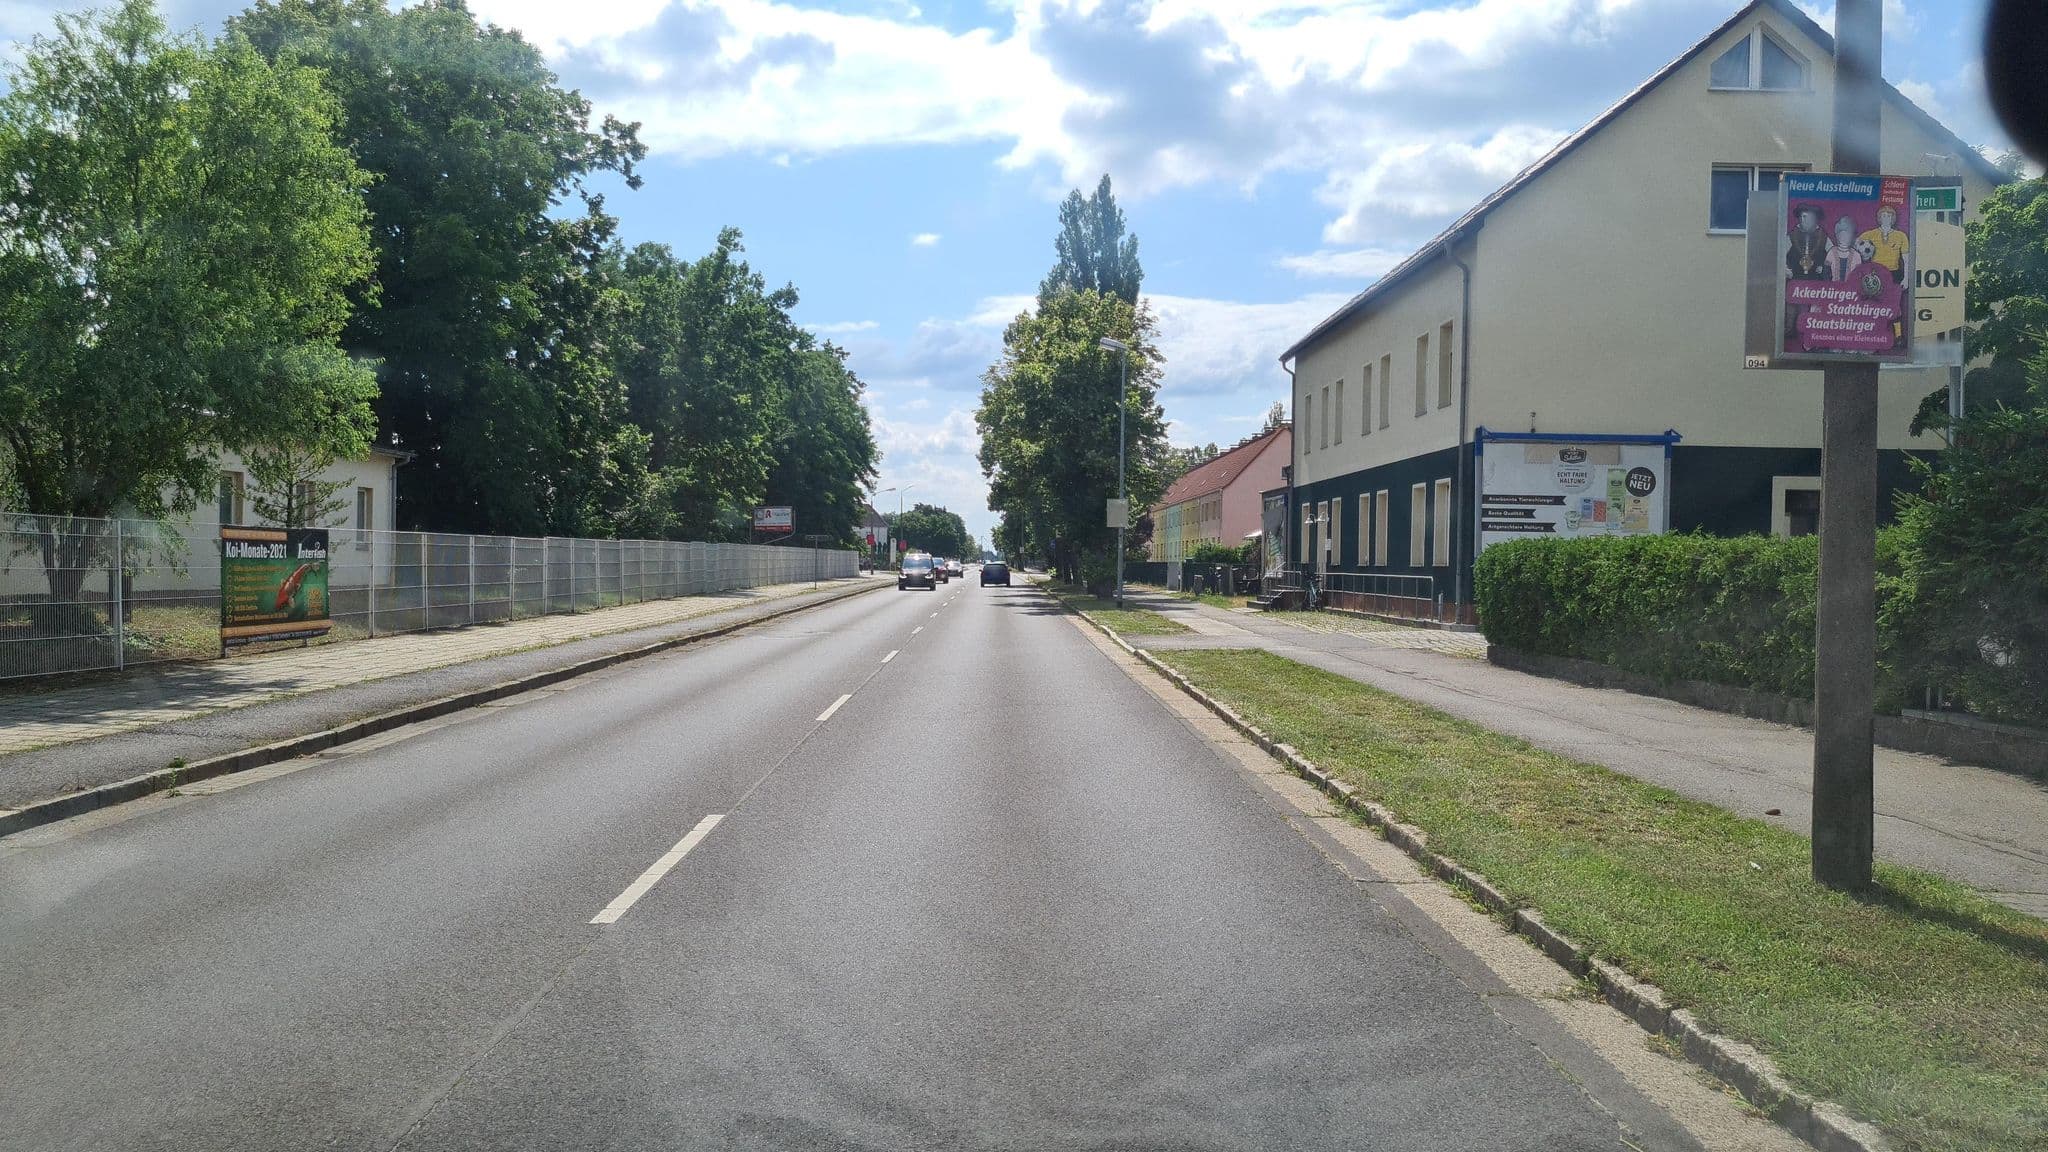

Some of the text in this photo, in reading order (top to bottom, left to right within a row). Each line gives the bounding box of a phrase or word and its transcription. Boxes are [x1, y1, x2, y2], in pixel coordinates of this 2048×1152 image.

[1789, 180, 1814, 192] Neue
[1816, 181, 1873, 196] Ausstellung
[1916, 195, 1936, 207] hen
[1916, 269, 1960, 288] ION
[1792, 286, 1858, 302] Ackerbürger,
[1827, 303, 1894, 319] Stadtbürger,
[1918, 308, 1933, 321] G
[1806, 317, 1876, 333] Staatsbürger
[1630, 473, 1652, 482] JETZT
[1629, 481, 1651, 491] NEU
[226, 542, 287, 559] Koi-Monate-2021
